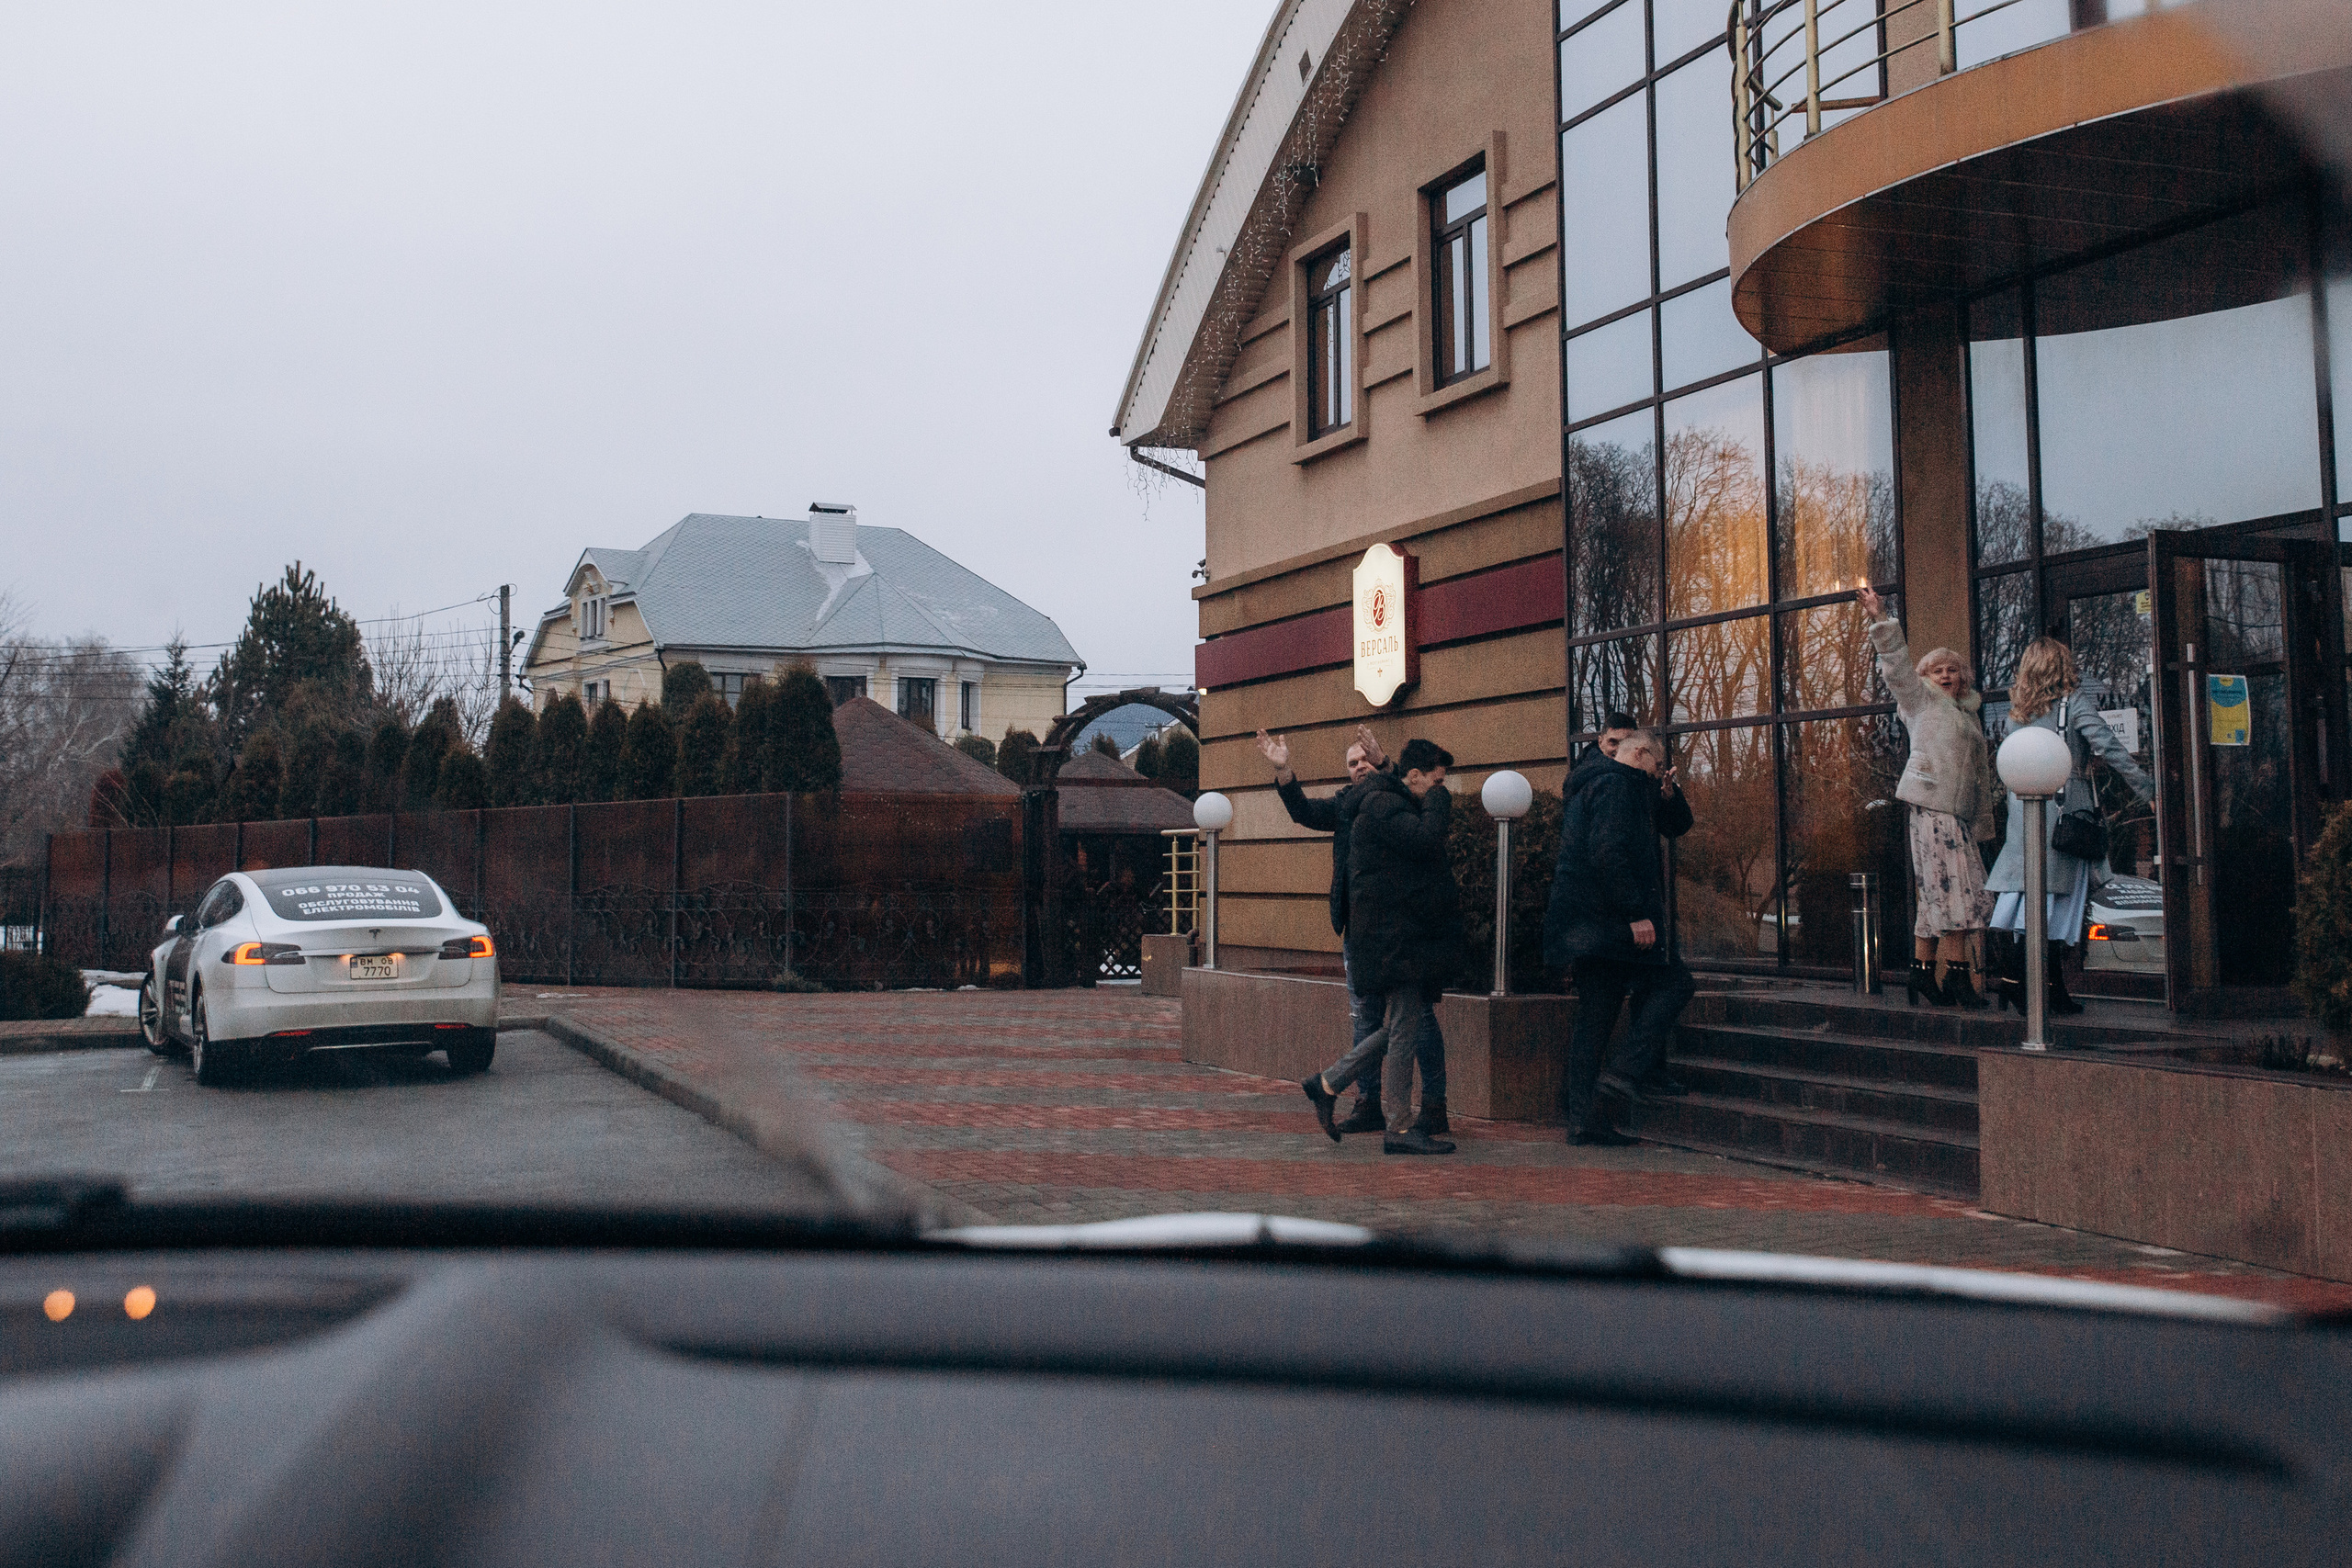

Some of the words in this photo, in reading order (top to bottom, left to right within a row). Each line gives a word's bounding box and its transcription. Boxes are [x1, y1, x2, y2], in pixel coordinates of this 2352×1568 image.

[1361, 635, 1398, 658] ВЕРСАЛЬ
[282, 886, 321, 897] 066
[367, 884, 390, 892] 53
[395, 886, 420, 894] 04
[299, 898, 420, 908] ОБСЛУГОВУВАННЯ
[302, 904, 421, 915] ЕЛЕКТРОМОБІЛІВ
[364, 966, 390, 976] 7770
